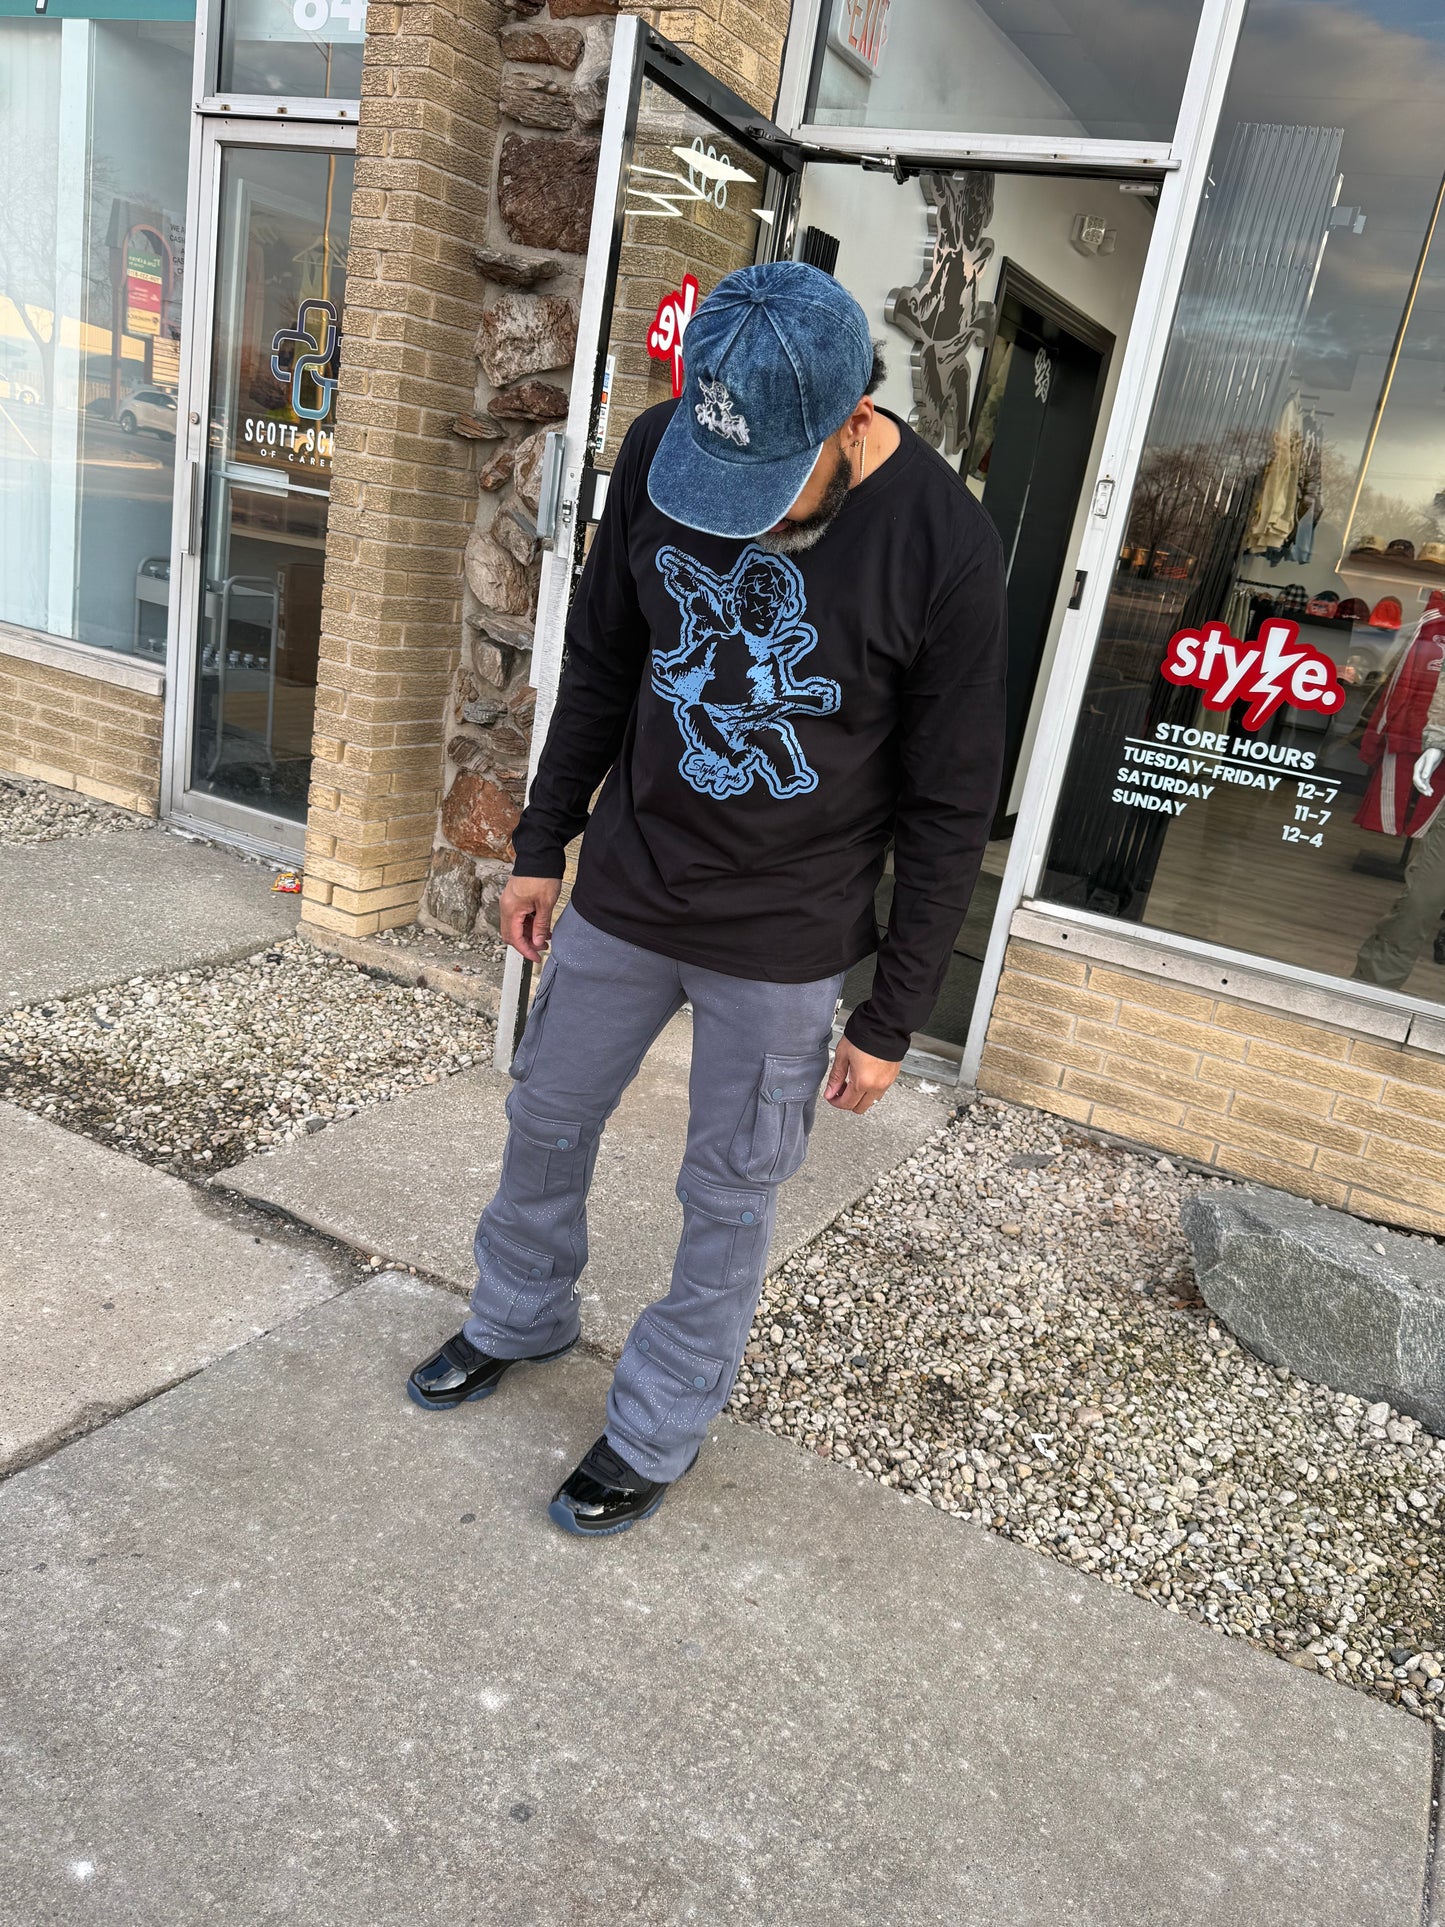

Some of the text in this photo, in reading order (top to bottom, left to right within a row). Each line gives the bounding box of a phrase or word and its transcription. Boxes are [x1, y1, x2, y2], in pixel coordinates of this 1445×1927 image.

[244, 418, 298, 448] SCOTT
[260, 448, 276, 458] OF
[1155, 722, 1317, 770] STORE HOURS
[1116, 767, 1332, 826] SATURDAY 11-7
[1123, 746, 1338, 804] TUESDAY-FRIDAY 12-7
[1111, 788, 1324, 848] SUNDAY 12-4
